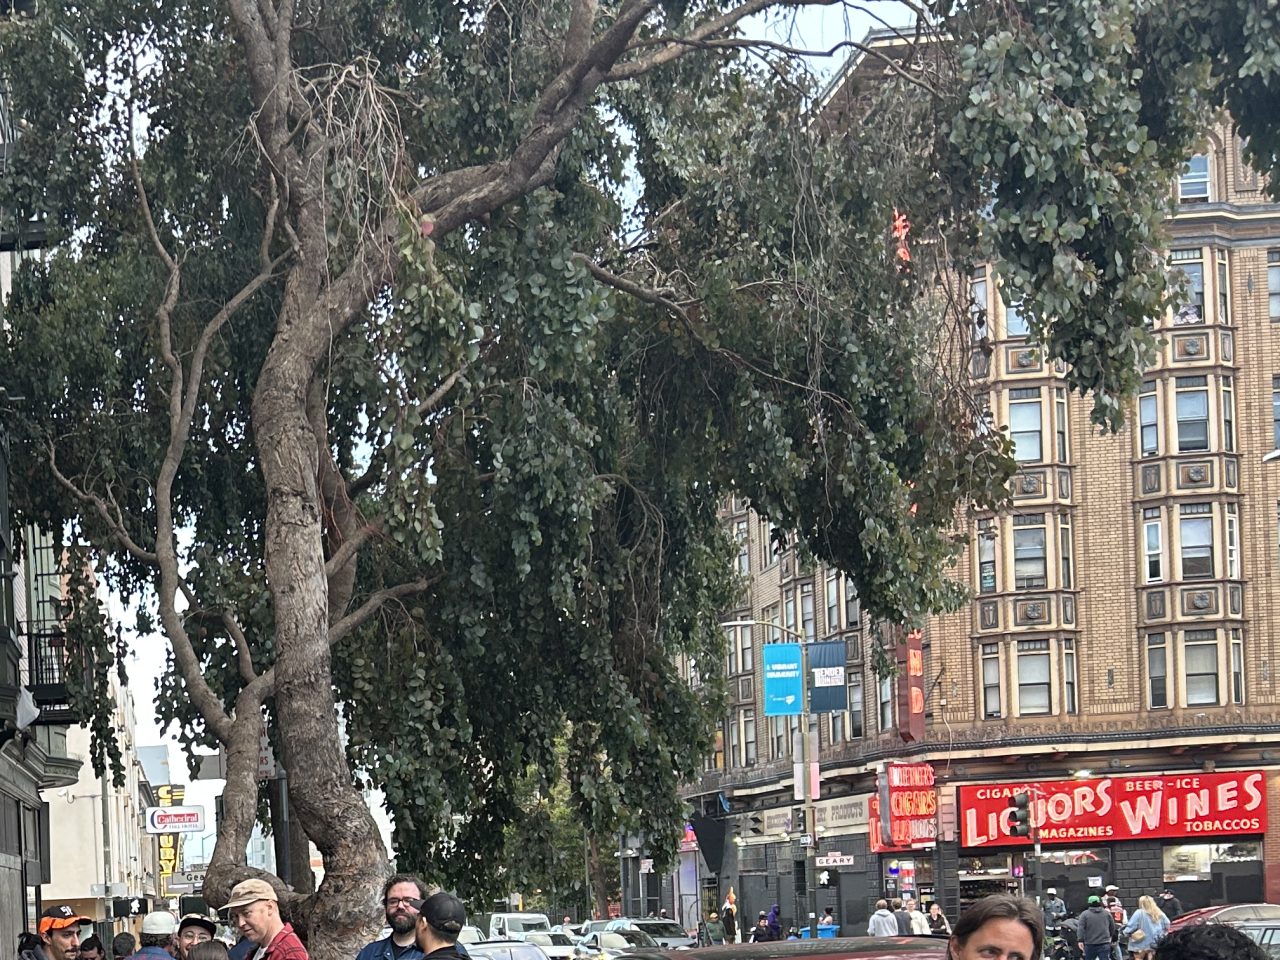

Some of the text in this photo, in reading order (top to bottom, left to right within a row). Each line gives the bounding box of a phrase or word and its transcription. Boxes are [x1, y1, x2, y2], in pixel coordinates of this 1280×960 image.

[976, 787, 1030, 799] CIGAR
[892, 790, 937, 816] CIGARS
[1121, 773, 1262, 835] WINES
[831, 801, 863, 820] PRODUCTS
[157, 813, 198, 824] Cathedral
[1184, 819, 1260, 832] TOBACCOS
[1039, 826, 1113, 839] MAGAZINES
[818, 857, 852, 865] GEARY
[186, 873, 205, 881] Gea
